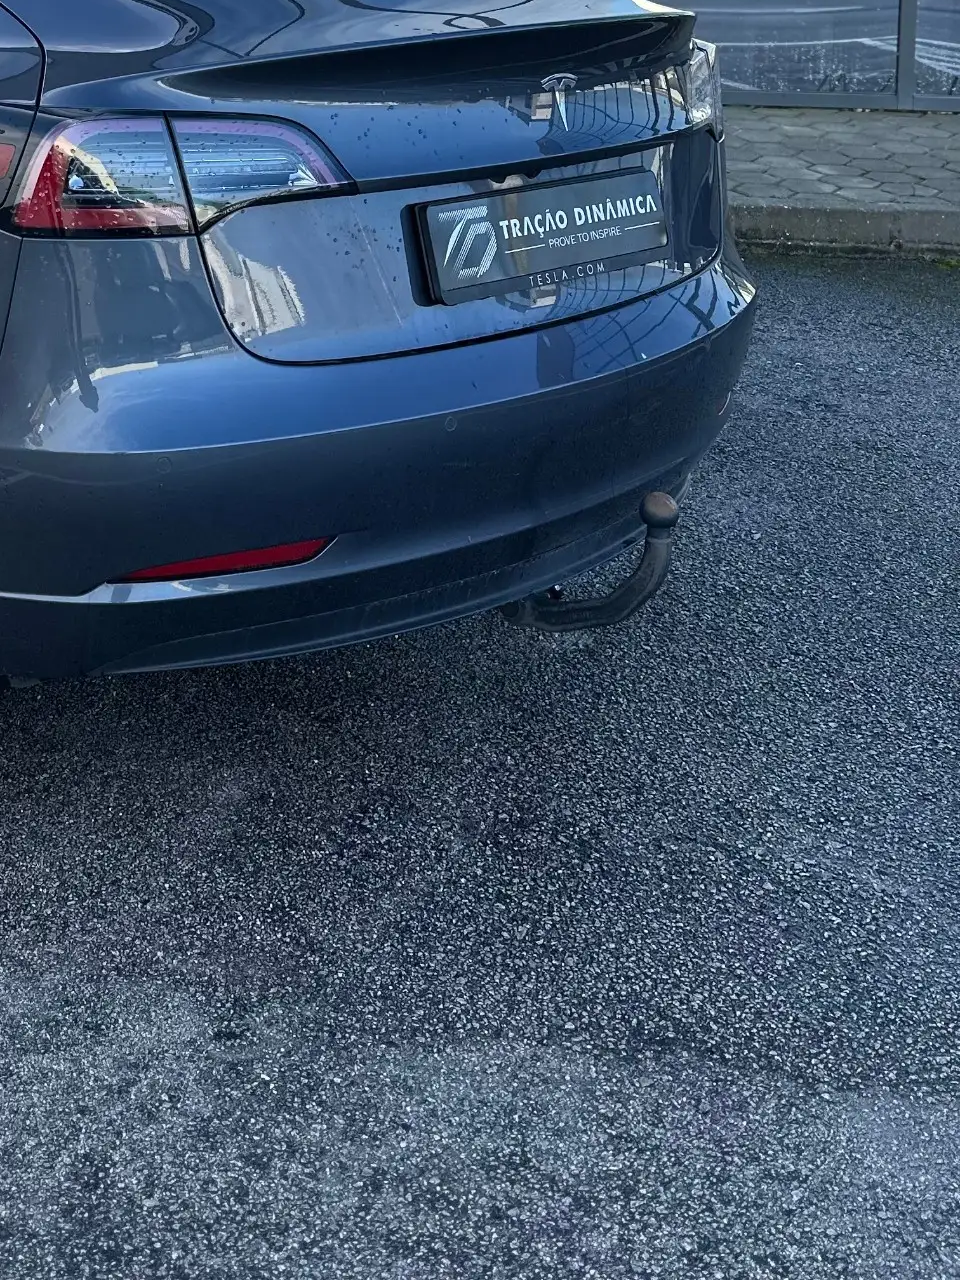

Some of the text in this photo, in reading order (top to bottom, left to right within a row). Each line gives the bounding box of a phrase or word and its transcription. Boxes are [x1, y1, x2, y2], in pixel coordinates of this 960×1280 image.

[499, 194, 658, 240] TRAÇÃO DINÂMICA
[548, 225, 622, 249] PROVE TO INSPIRE
[528, 261, 605, 287] TESLA.COM
